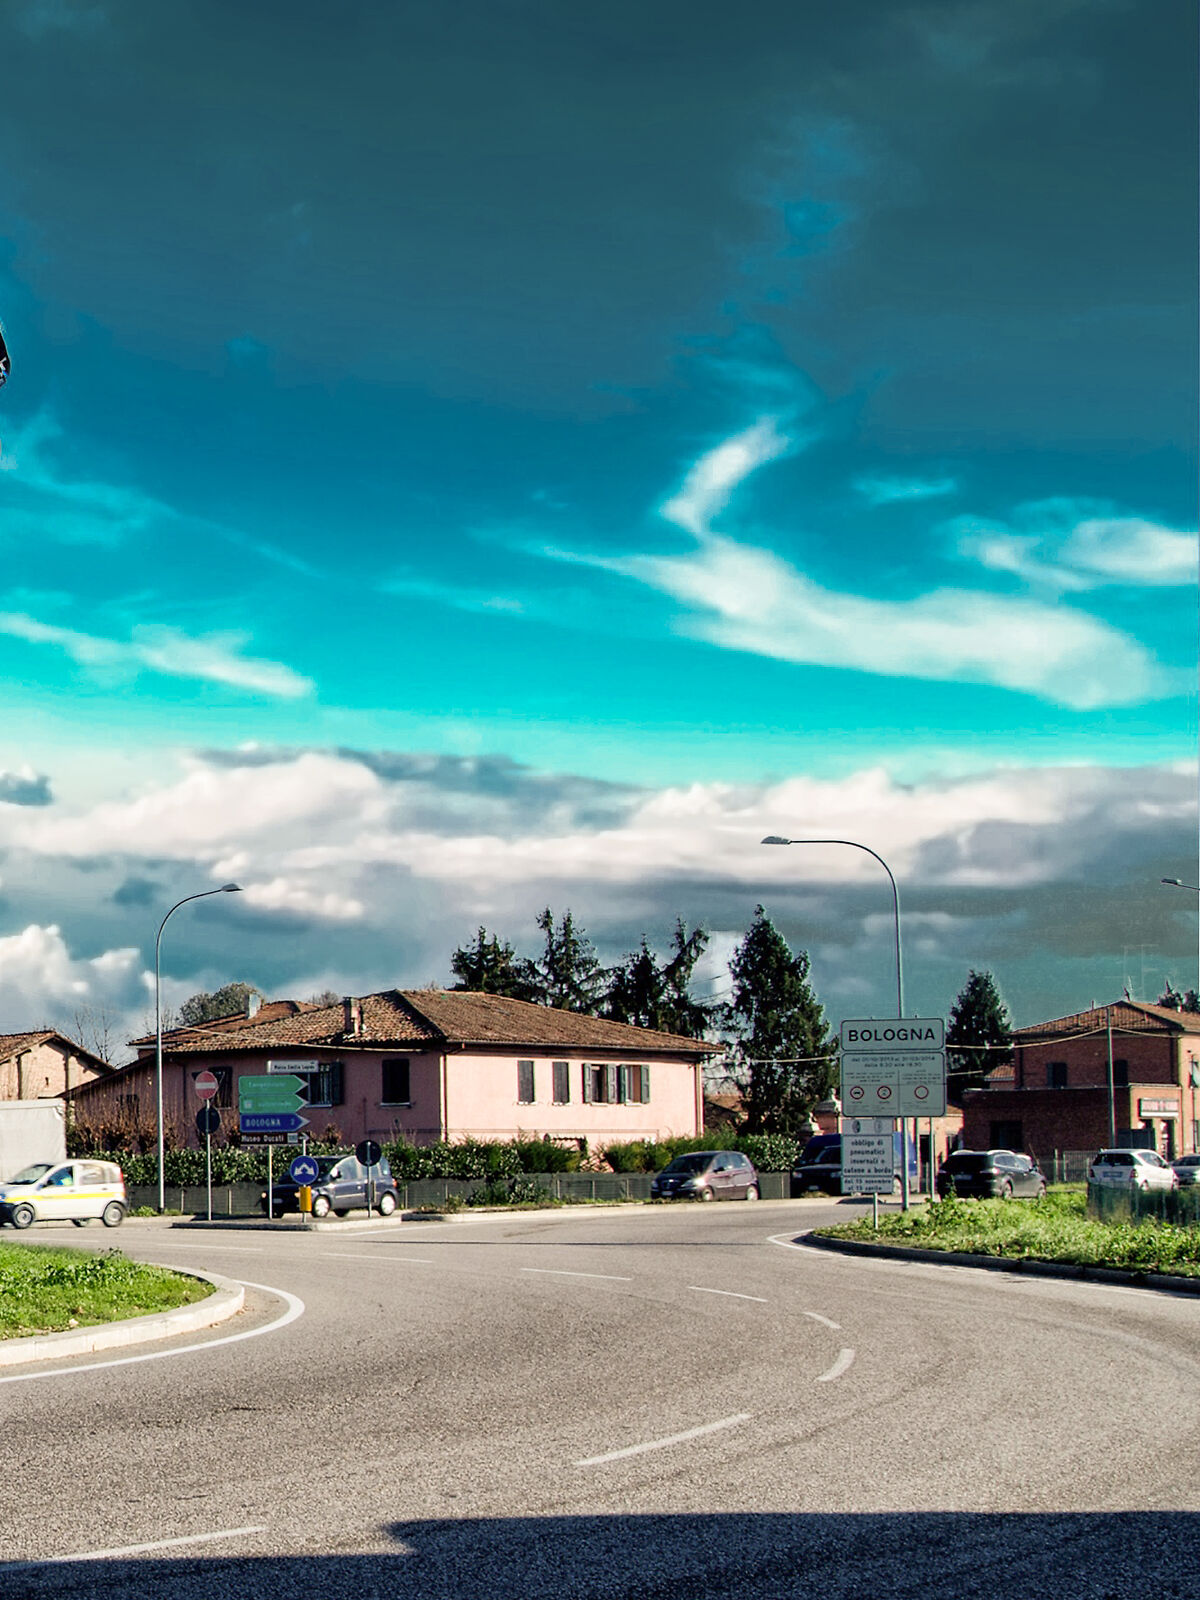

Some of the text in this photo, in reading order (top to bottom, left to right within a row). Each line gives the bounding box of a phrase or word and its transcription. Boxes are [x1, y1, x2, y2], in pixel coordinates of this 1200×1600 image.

[848, 1028, 935, 1042] BOLOGNA
[245, 1118, 281, 1127] BOLOGNA
[241, 1134, 284, 1142] Museo Ducati
[851, 1139, 875, 1147] obbligo
